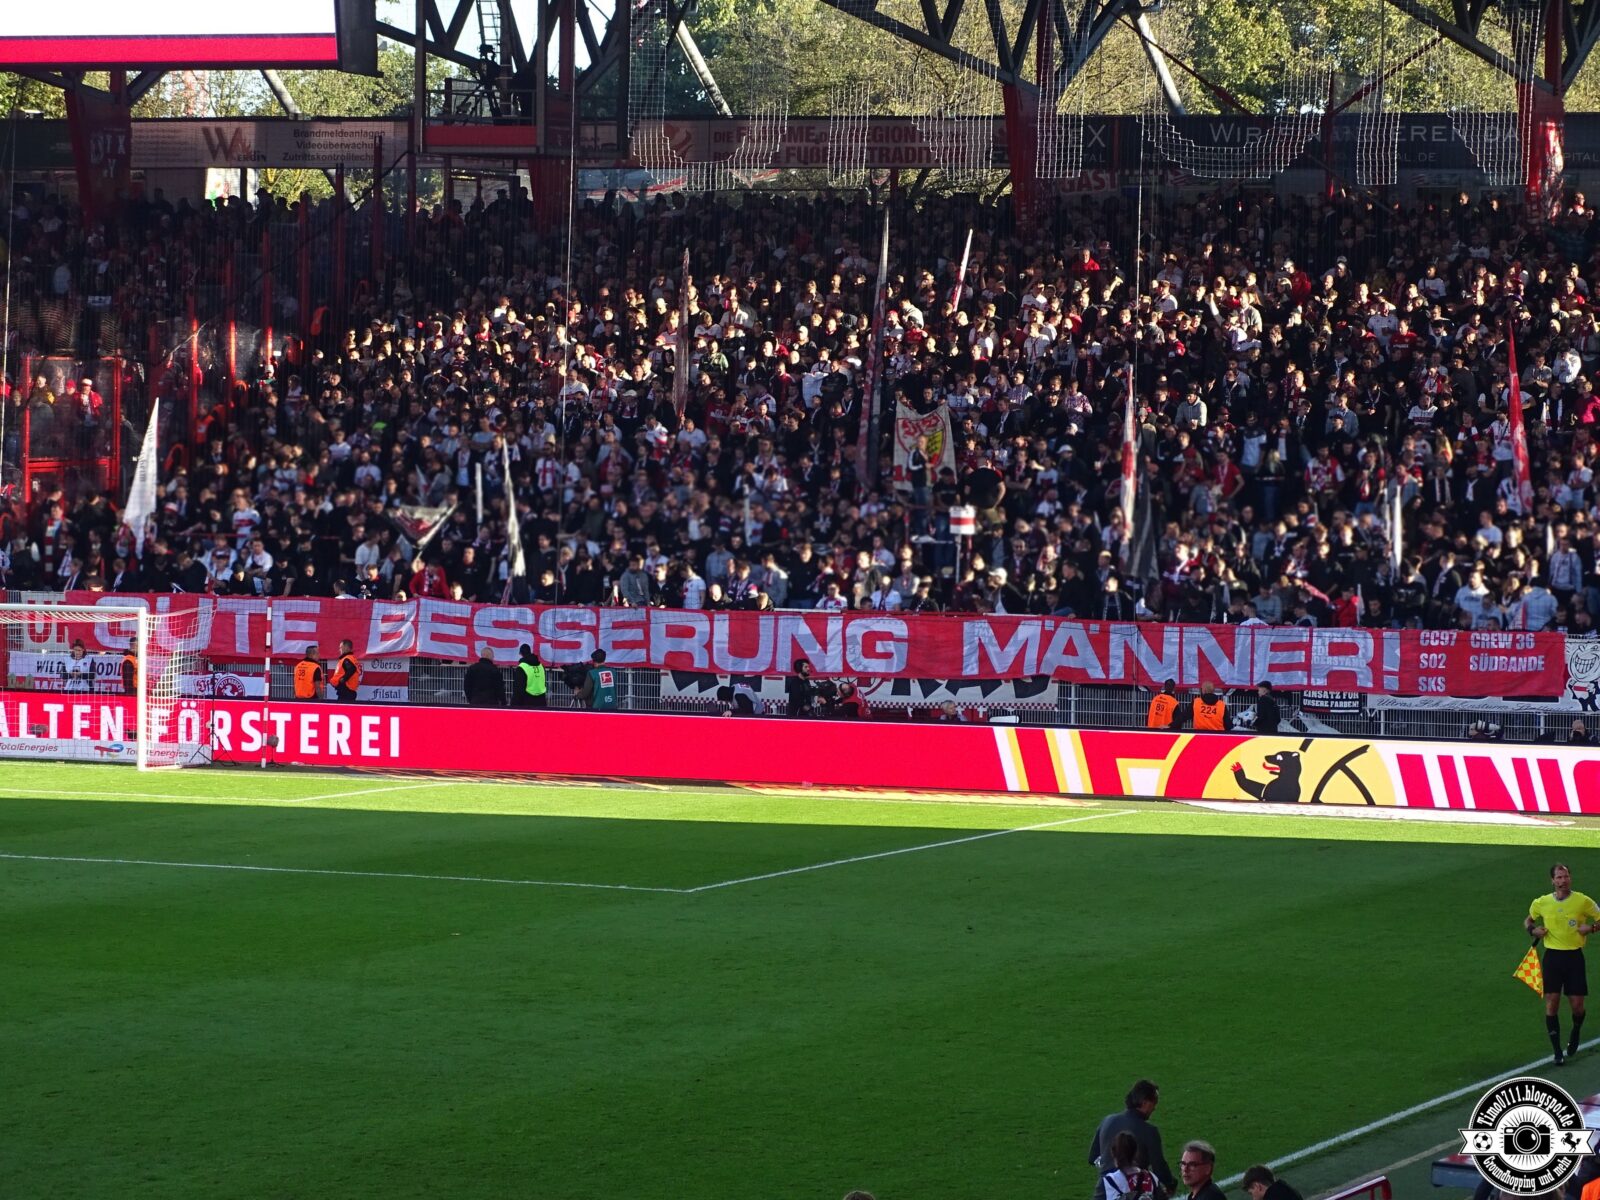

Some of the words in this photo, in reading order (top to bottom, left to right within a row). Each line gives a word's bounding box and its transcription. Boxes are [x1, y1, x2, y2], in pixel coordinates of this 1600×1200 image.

[713, 131, 734, 143] DIE
[93, 595, 321, 658] GUTE
[366, 599, 908, 674] BESSERUNG
[962, 619, 1400, 692] MÄNNER!
[1420, 631, 1457, 647] CC97
[1470, 632, 1513, 648] CREW
[1515, 634, 1536, 650] 36
[371, 659, 402, 670] Oberes
[1469, 654, 1545, 672] SÜDBANDE
[1418, 676, 1446, 692] SKS
[371, 688, 401, 700] Filstal
[1156, 703, 1165, 712] 89
[1302, 699, 1329, 707] UNSERE
[1201, 705, 1217, 715] 224
[150, 700, 401, 757] FÖRSTEREI
